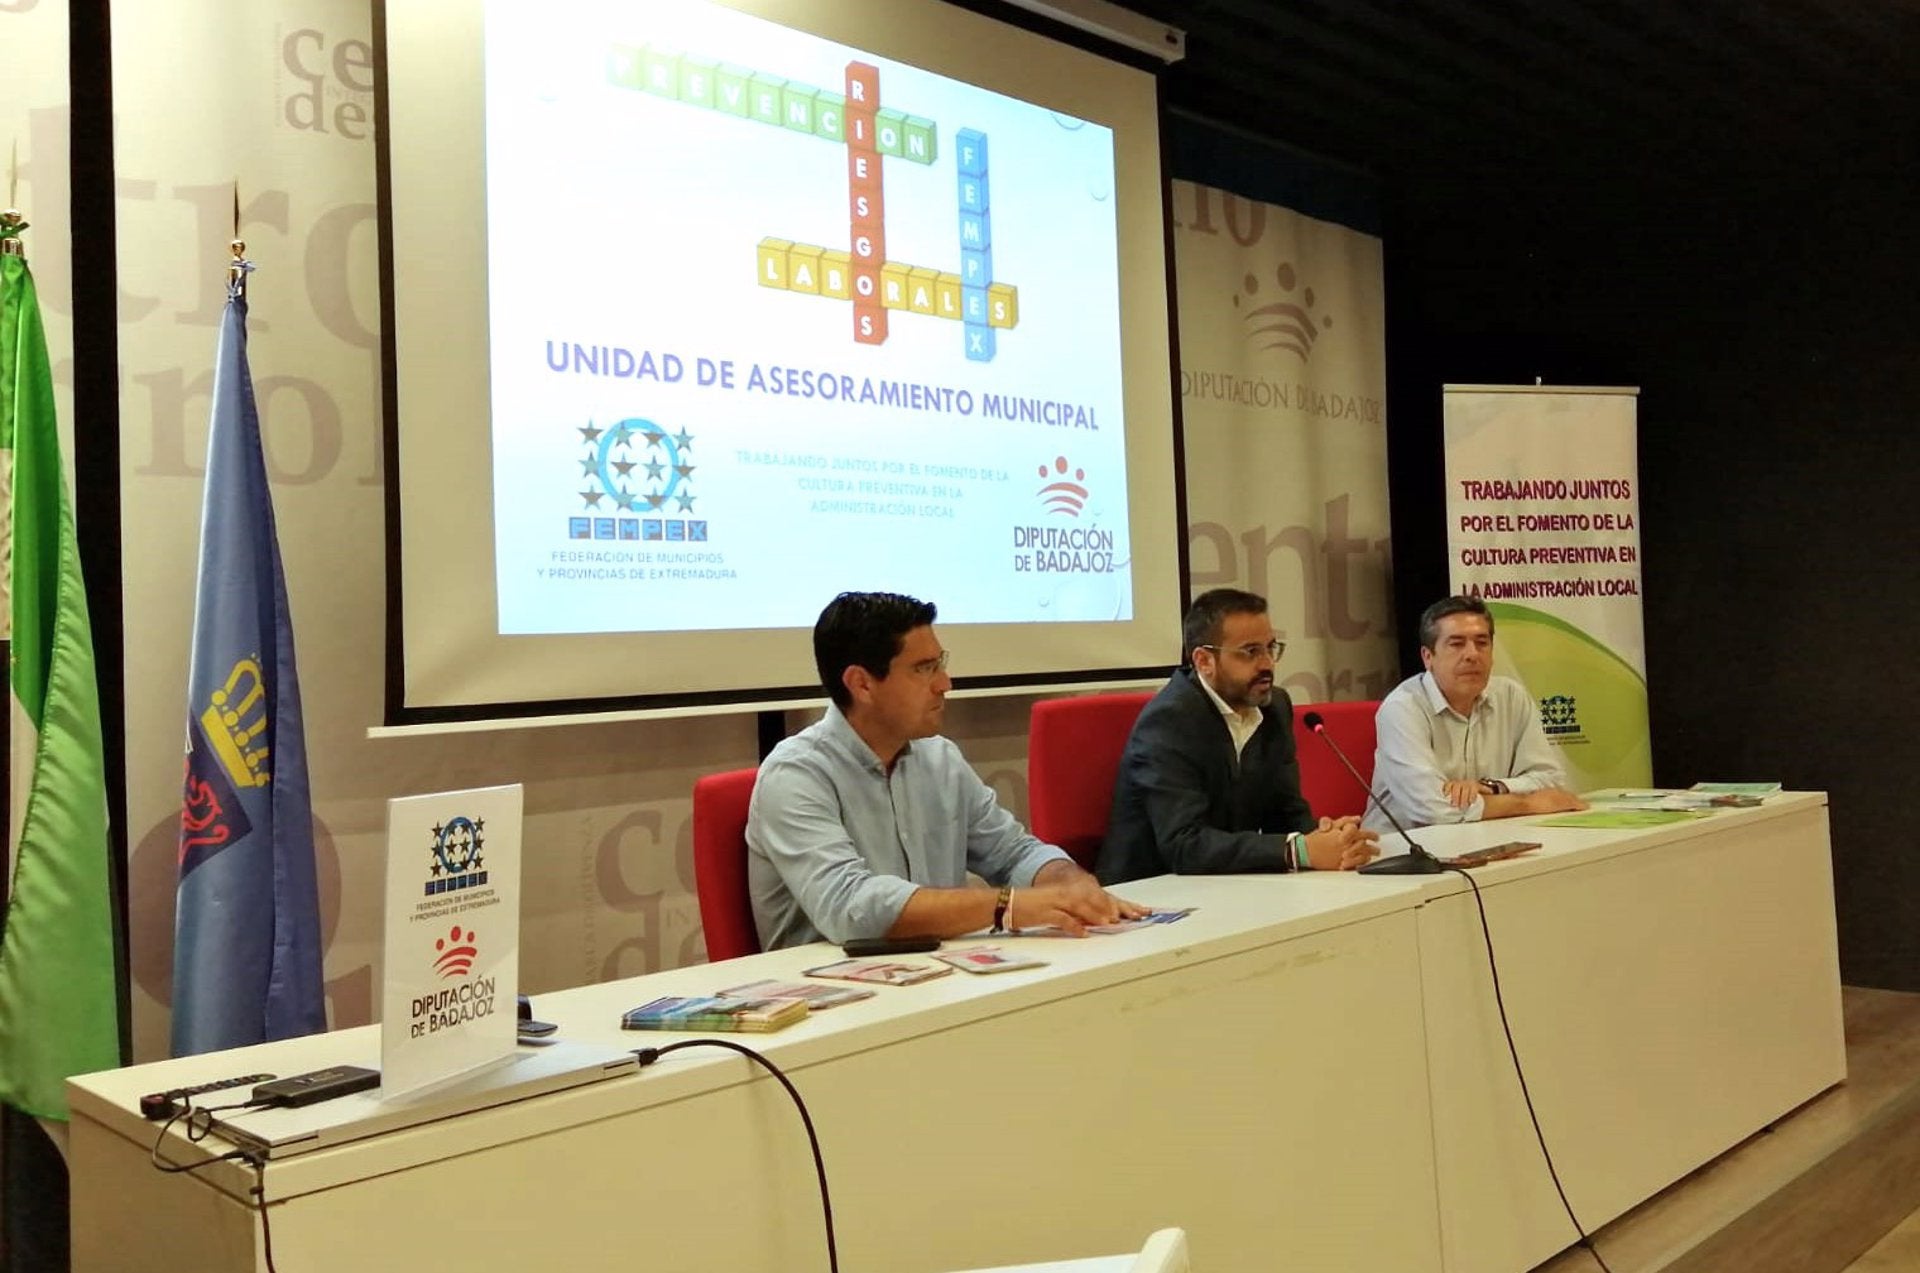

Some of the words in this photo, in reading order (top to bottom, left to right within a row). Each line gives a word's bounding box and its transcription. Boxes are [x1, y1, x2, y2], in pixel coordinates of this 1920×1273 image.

[766, 256, 1006, 321] LABORALES
[546, 340, 684, 383] UNIDAD
[696, 357, 735, 389] DE
[746, 363, 974, 416] ASESORAMIENTO
[982, 393, 1099, 431] MUNICIPAL
[1461, 480, 1567, 501] TRABAJANDO
[1569, 480, 1631, 500] JUNTOS
[568, 516, 708, 542] FEMPEX
[1460, 515, 1494, 533] POR
[1496, 515, 1515, 532] EL
[1517, 514, 1590, 532] FOMENTO
[1593, 514, 1614, 531] DE
[1616, 513, 1635, 531] LA
[1013, 522, 1114, 551] DIPUTACIÓN
[1014, 554, 1032, 572] DE
[1035, 550, 1115, 573] BADAJOZ
[1461, 548, 1527, 566] CULTURA
[1530, 546, 1617, 565] PREVENTIVA
[1619, 546, 1637, 563] EN
[1463, 582, 1481, 599] LA
[1484, 576, 1595, 599] ADMINISTRACIÓN
[1597, 579, 1639, 597] LOCAL
[412, 975, 495, 1019] DIPUTACIÓN
[411, 1021, 426, 1039] DE
[429, 997, 495, 1034] BADAJOZ
